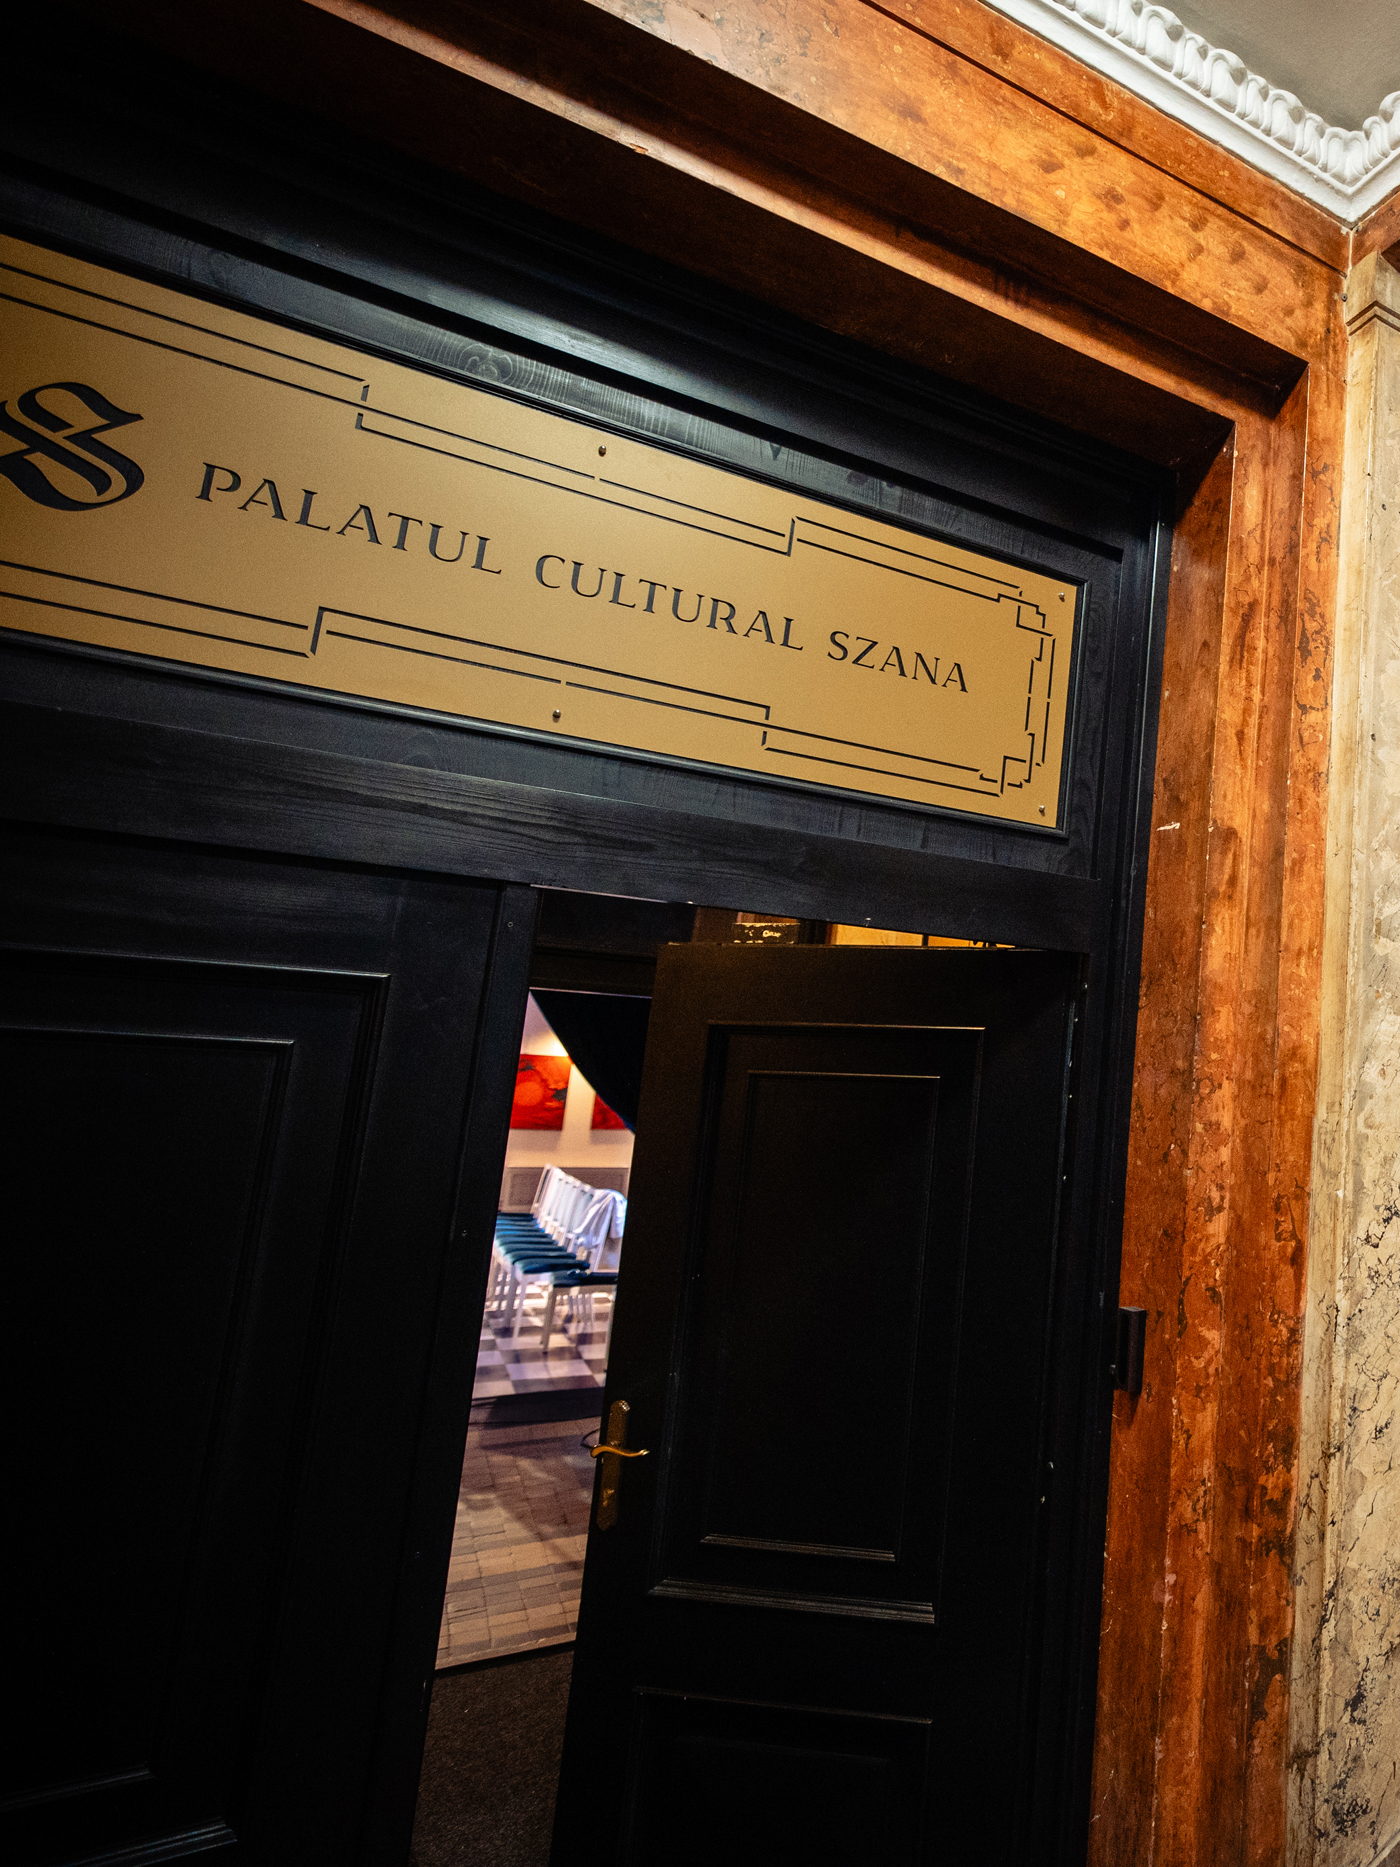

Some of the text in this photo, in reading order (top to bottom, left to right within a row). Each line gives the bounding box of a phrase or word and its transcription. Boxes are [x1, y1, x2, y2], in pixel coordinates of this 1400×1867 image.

[195, 462, 969, 693] PALATUL CULTURAL SZANA
